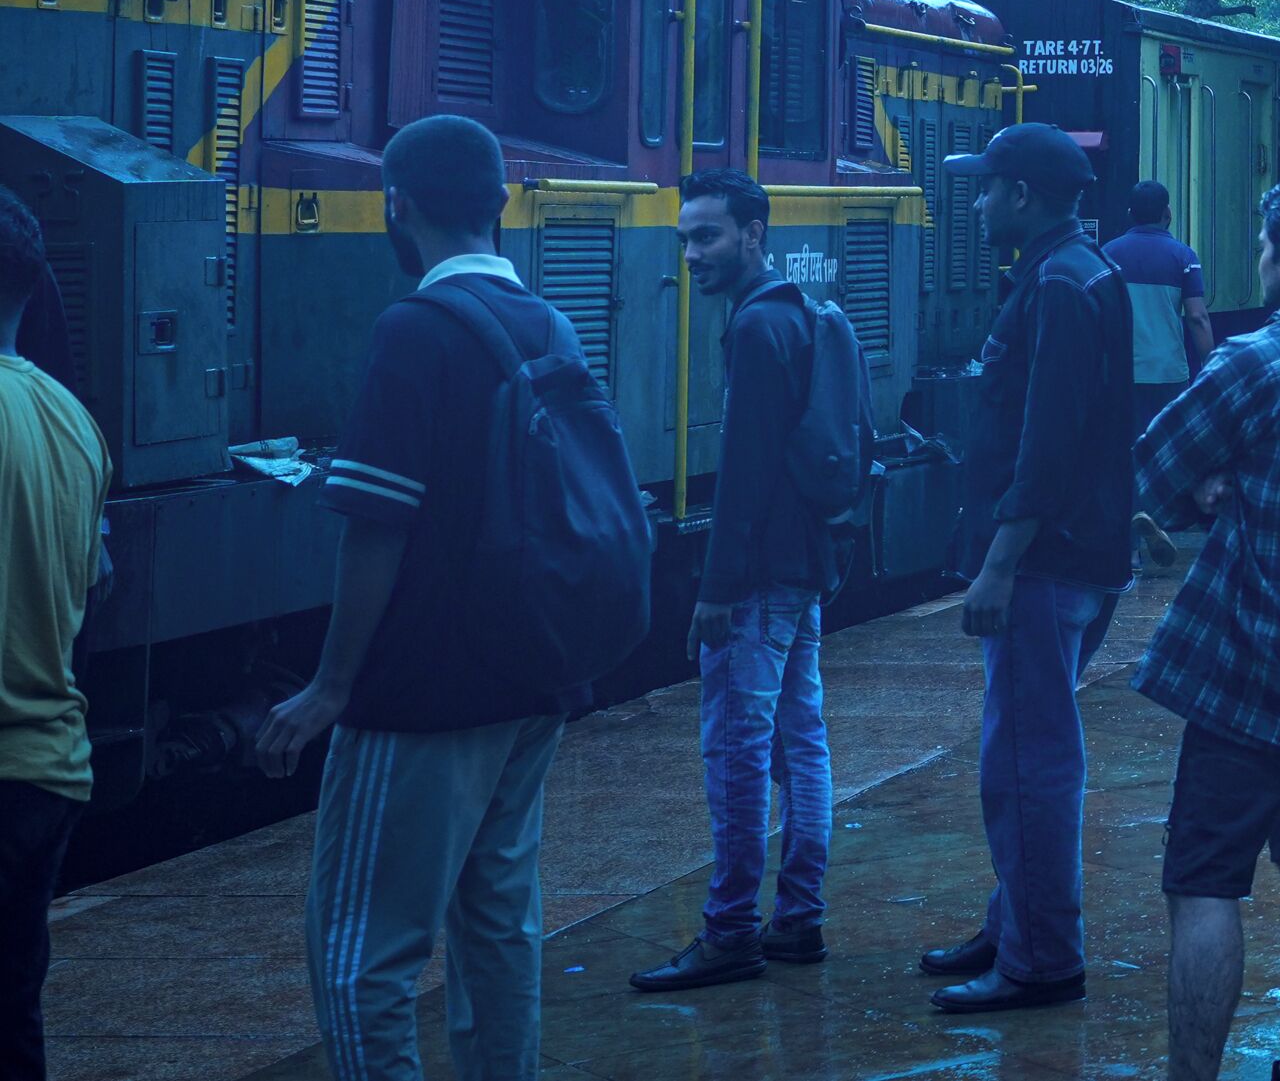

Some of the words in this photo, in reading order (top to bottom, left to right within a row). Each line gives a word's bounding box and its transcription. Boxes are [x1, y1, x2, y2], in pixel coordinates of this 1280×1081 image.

[1023, 40, 1065, 56] TARE
[1018, 59, 1077, 74] RETURN
[1080, 56, 1113, 78] 03/26
